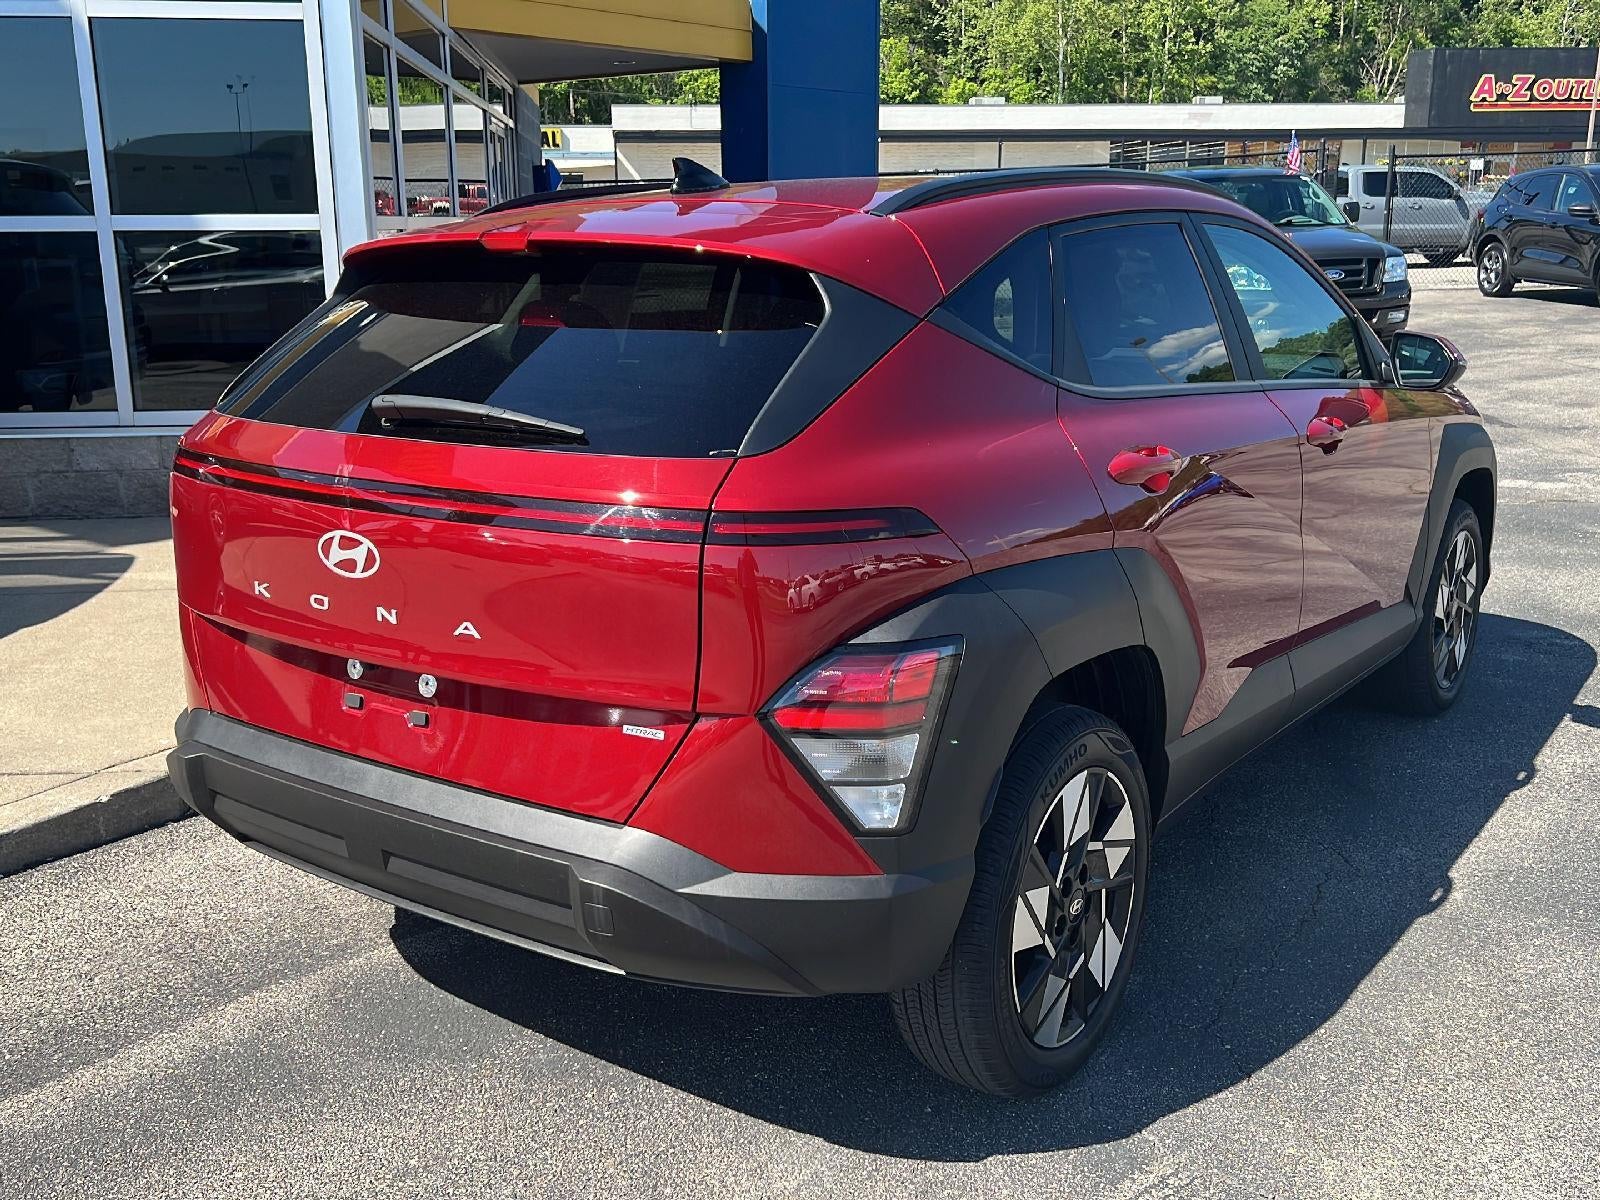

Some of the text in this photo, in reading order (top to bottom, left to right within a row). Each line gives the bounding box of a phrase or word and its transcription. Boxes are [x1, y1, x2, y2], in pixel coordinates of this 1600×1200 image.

[1533, 78, 1600, 100] OUTL
[254, 580, 481, 639] KONA
[625, 727, 662, 739] HTRAC
[1042, 743, 1088, 803] KUMHO
